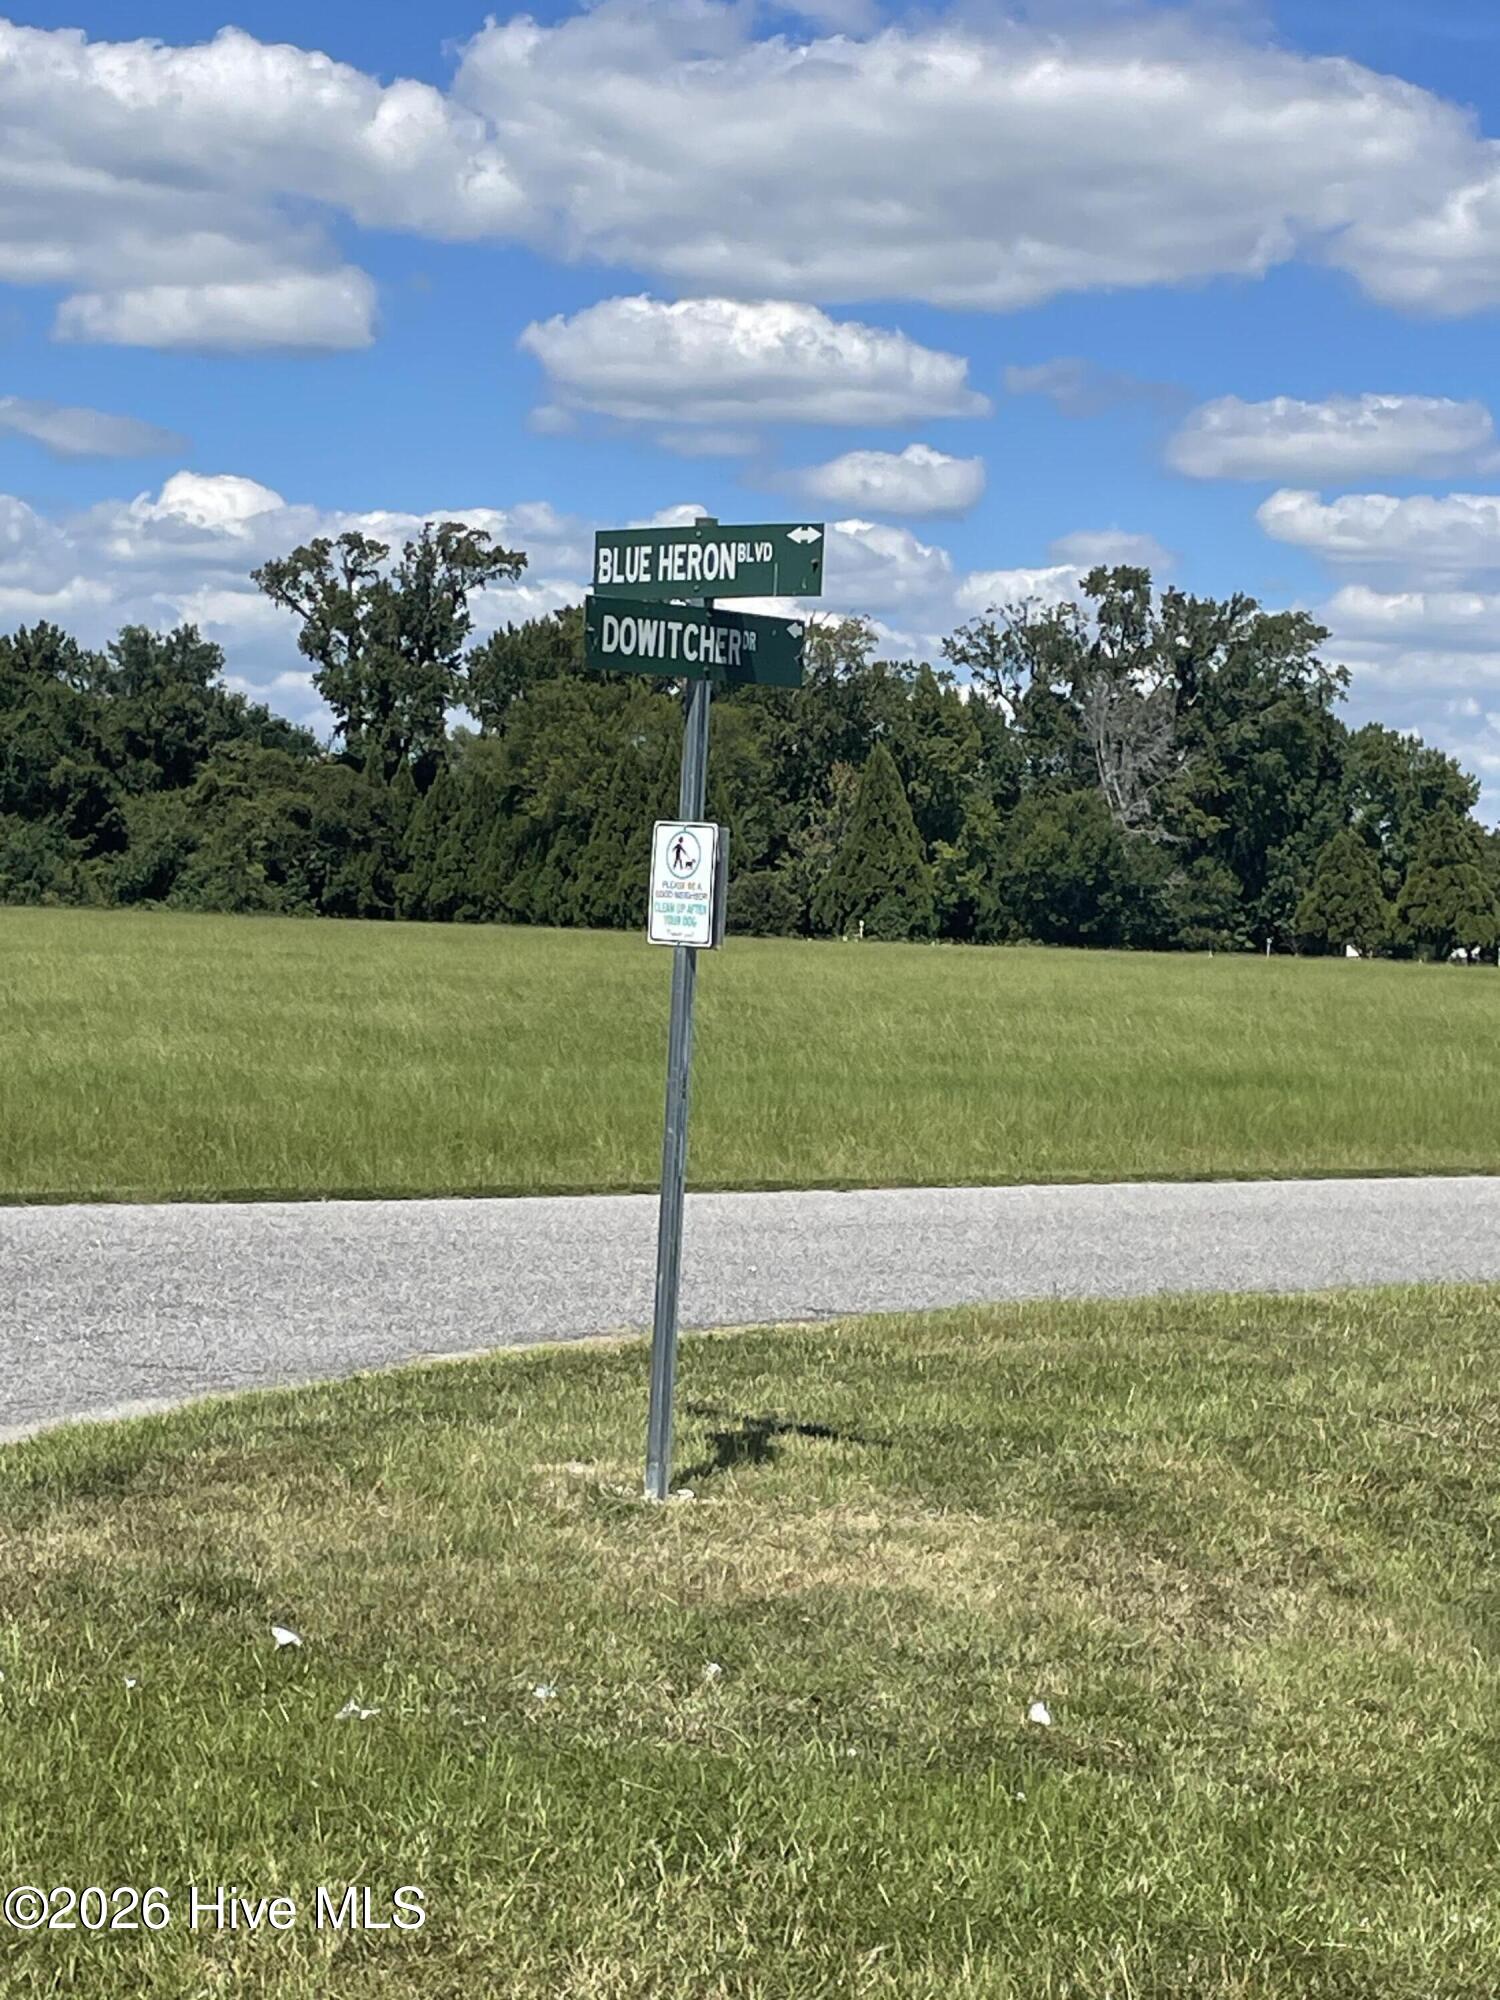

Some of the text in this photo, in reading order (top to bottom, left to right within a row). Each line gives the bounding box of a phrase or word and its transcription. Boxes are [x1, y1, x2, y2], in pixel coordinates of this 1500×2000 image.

[597, 541, 773, 584] BLUE HERON BLVD
[601, 614, 757, 666] DOWITCHER DR
